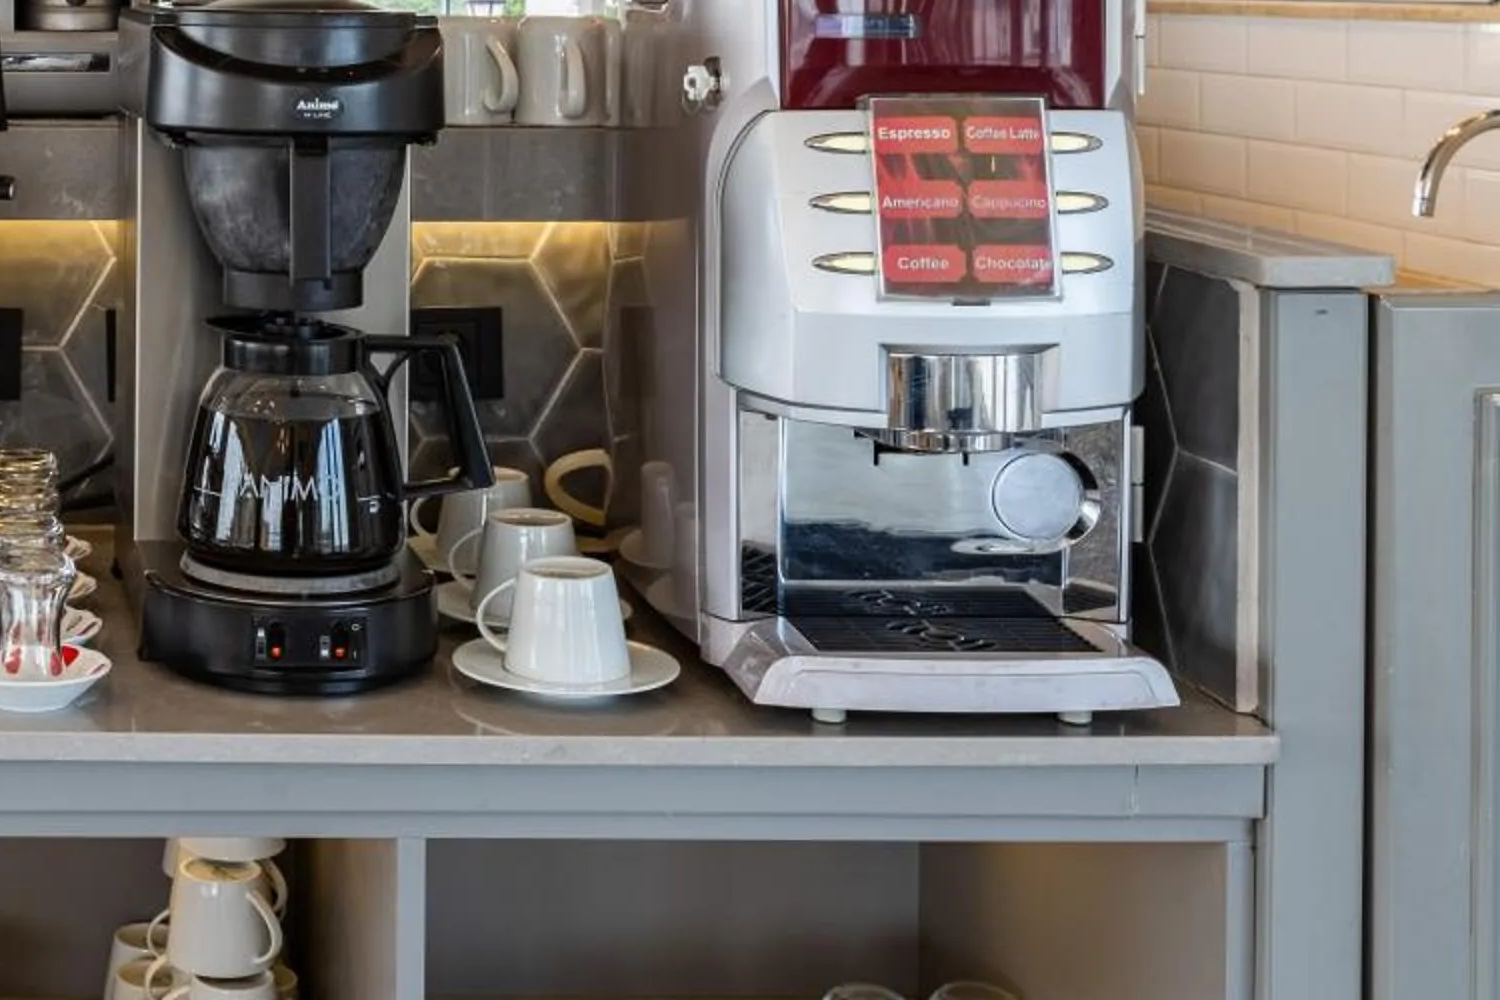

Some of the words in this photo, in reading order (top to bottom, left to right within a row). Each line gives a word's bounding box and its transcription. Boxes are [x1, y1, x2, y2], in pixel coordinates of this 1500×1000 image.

[878, 127, 951, 141] Espresso
[966, 126, 1007, 139] Coffee
[882, 195, 959, 210] Americano
[897, 256, 950, 270] Coffee
